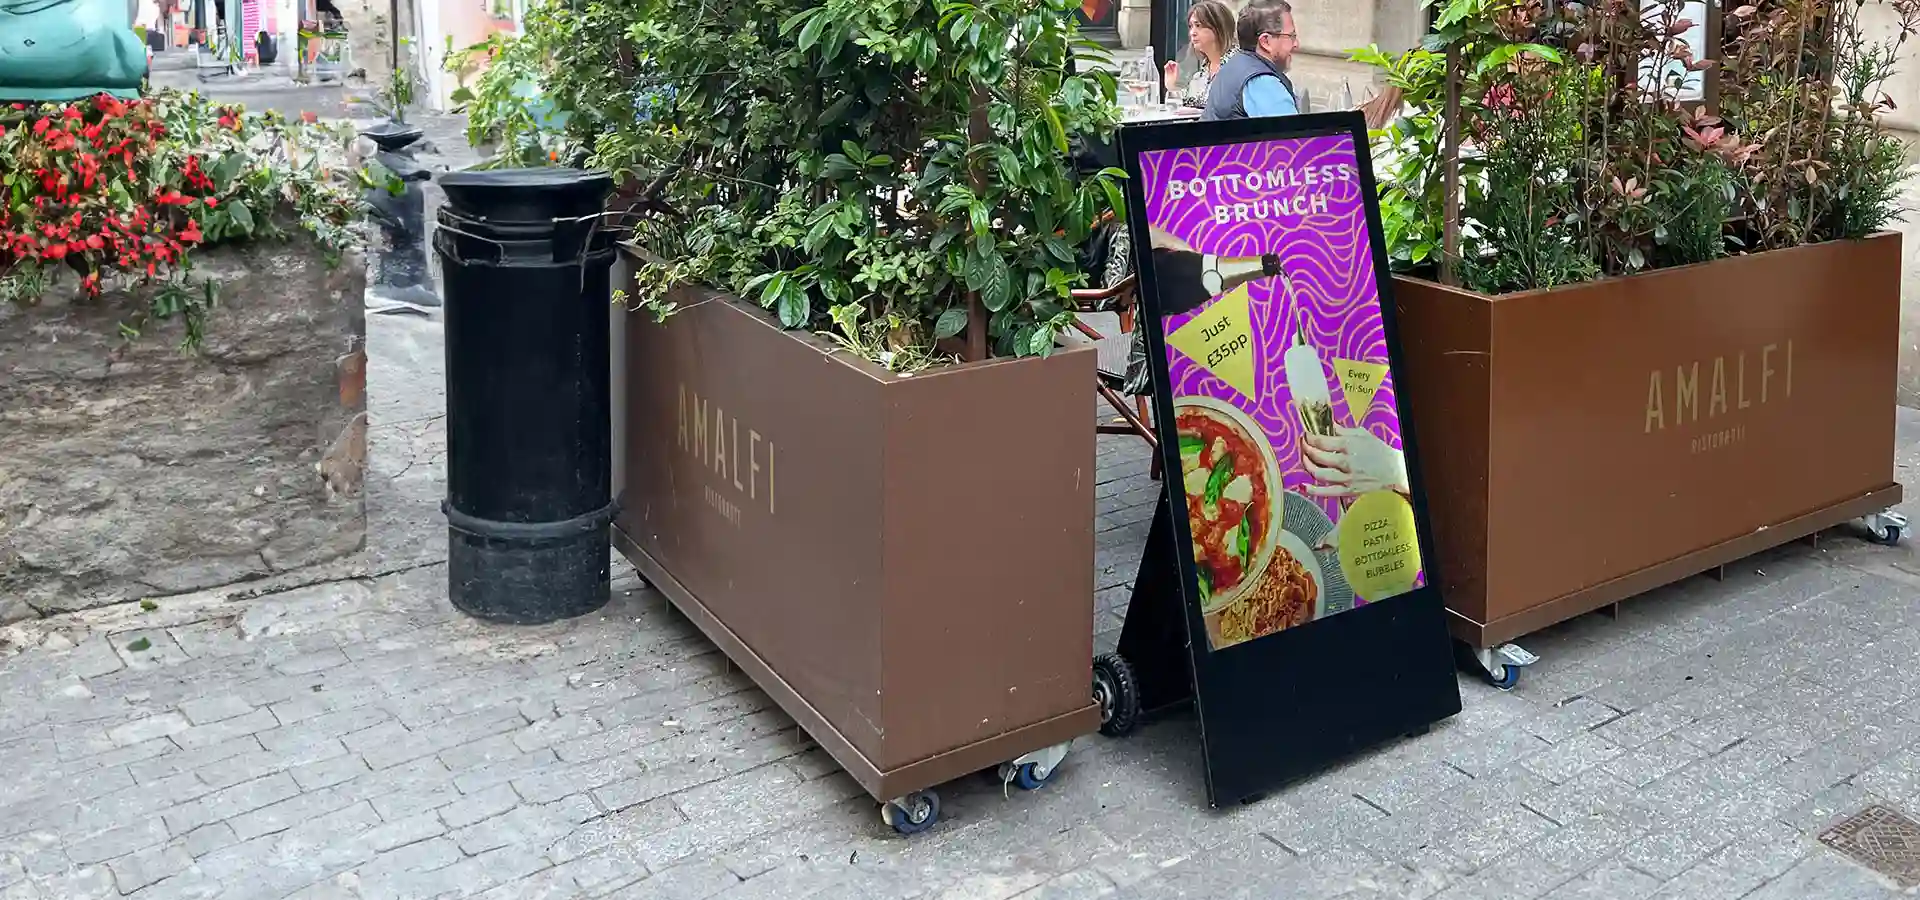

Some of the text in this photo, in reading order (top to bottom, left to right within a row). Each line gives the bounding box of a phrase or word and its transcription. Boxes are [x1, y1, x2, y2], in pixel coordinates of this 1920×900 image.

[1168, 163, 1350, 200] BOTTOMLESS
[1214, 193, 1328, 224] BRUNCH
[1201, 316, 1231, 342] Just
[1207, 333, 1247, 368] £35pp
[1348, 369, 1370, 381] Every
[1645, 339, 1792, 433] AMALFI
[677, 382, 775, 514] AMALFI
[1354, 543, 1412, 566] BOTTOMLESS
[1363, 532, 1389, 549] PASTA
[1366, 560, 1404, 579] BUBBLES
